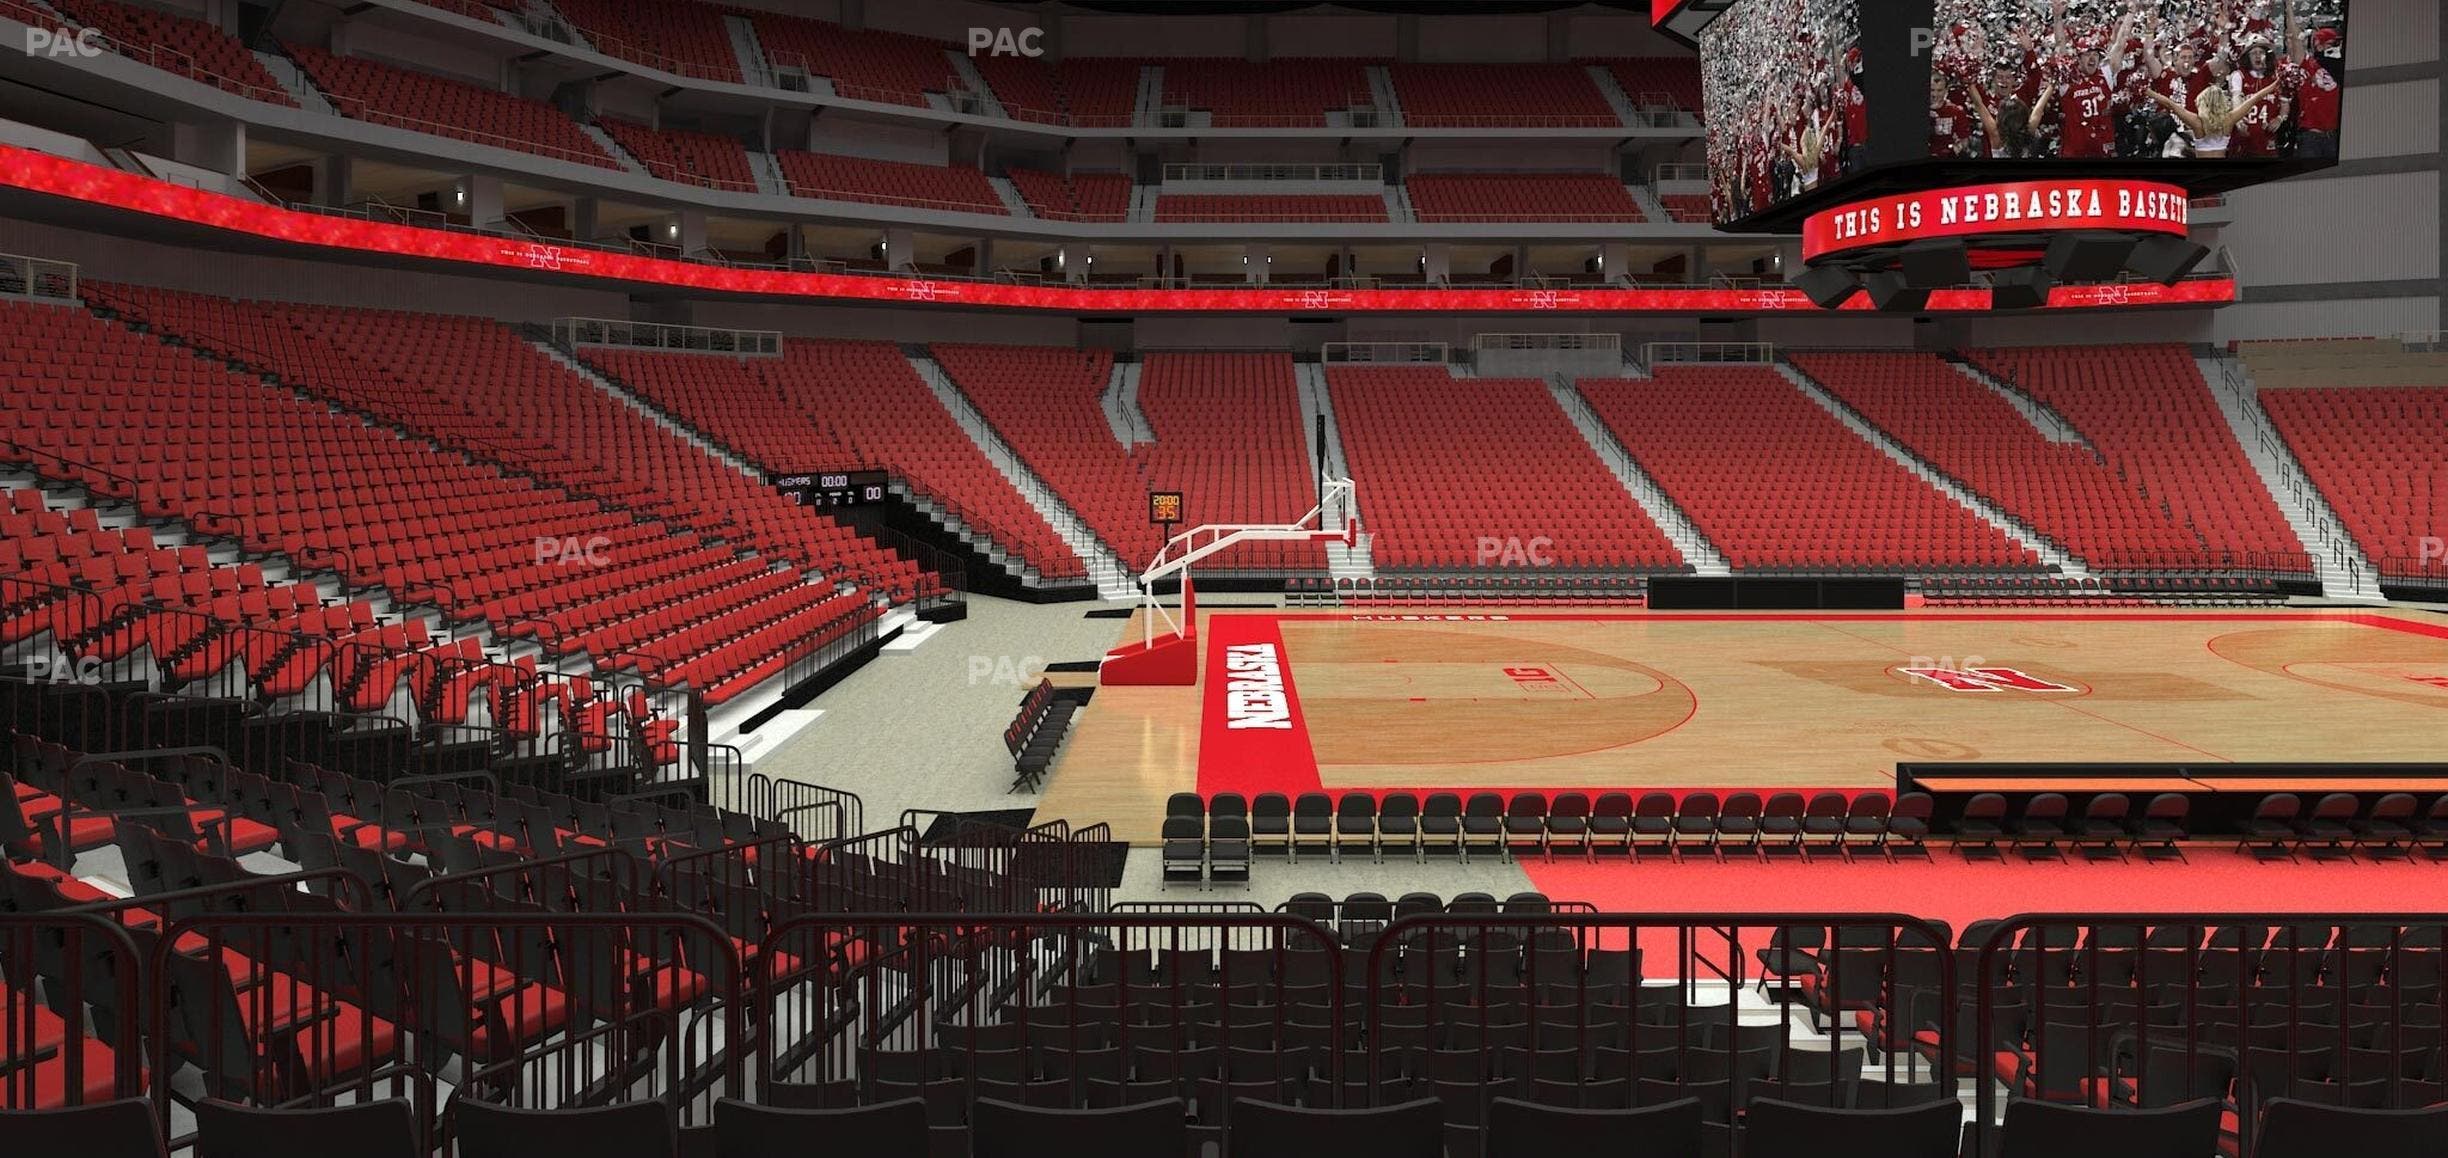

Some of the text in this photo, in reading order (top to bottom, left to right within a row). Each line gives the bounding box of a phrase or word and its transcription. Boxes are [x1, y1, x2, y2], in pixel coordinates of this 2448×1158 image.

[2082, 97, 2099, 117] 31
[2248, 105, 2267, 124] 24
[1834, 207, 1880, 240] THIS
[1896, 201, 1922, 229] IS
[1940, 188, 2101, 225] NEBRASKA
[866, 487, 881, 500] 00
[1226, 643, 1293, 729] NEBRASKA
